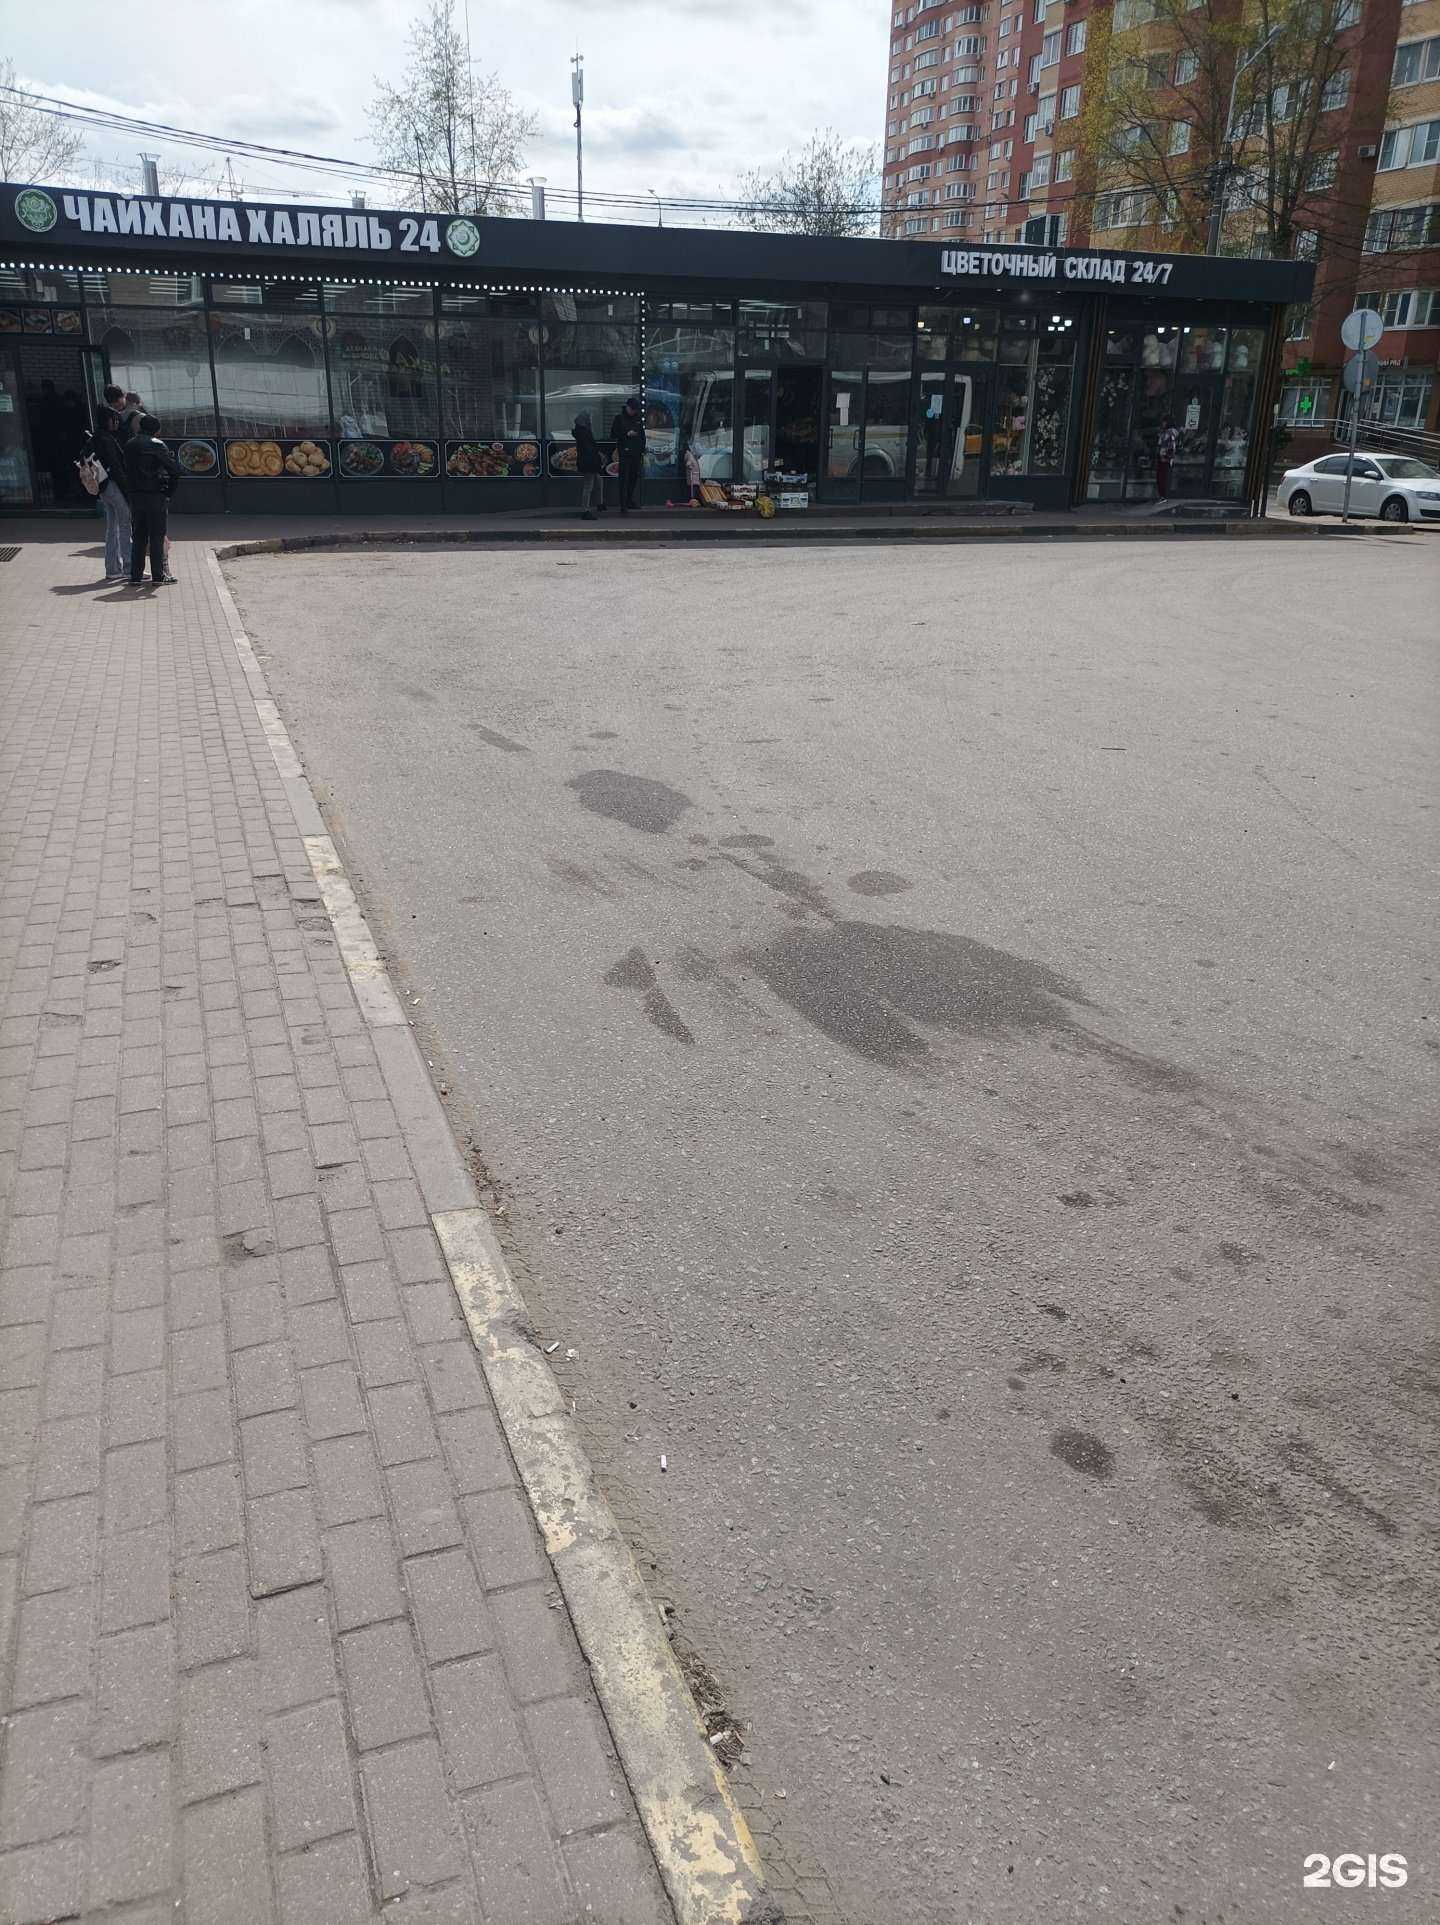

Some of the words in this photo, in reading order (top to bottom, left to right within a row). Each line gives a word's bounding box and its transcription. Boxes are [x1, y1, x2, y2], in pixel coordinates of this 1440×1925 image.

[63, 194, 242, 241] ЧАЙХАНА
[246, 210, 392, 250] ХАЛЯЛЬ
[399, 218, 441, 252] 24
[941, 250, 1056, 278] ЦВЕТОЧНЫЙ
[1064, 256, 1126, 284] СКЛАД
[1132, 261, 1174, 285] 24/7
